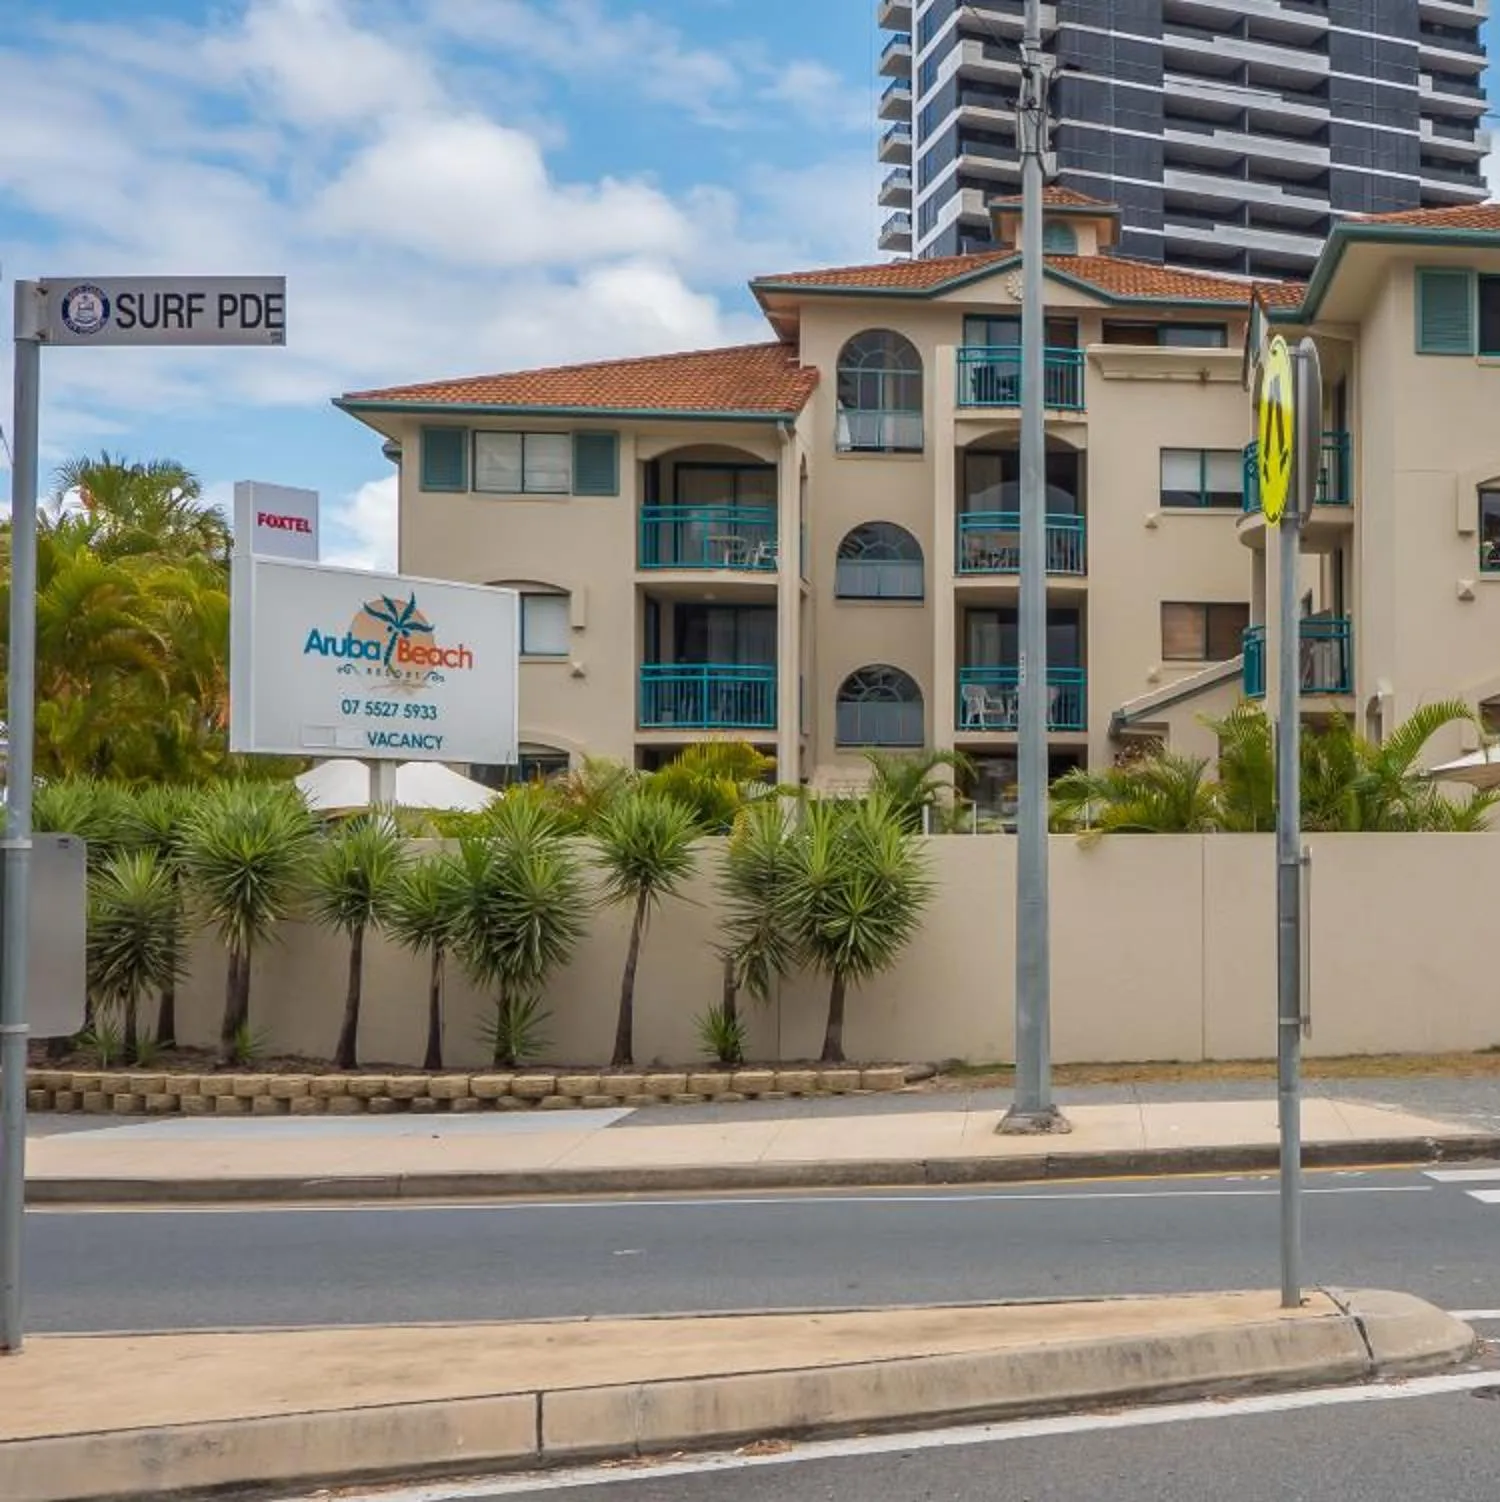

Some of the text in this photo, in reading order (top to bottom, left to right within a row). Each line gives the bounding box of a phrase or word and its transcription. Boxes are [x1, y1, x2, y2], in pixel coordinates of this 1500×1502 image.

[116, 293, 206, 329] SURF
[218, 293, 284, 329] PDE
[257, 511, 313, 533] FOXTEL
[303, 628, 473, 669] Aruba Beach
[341, 699, 438, 720] 07 5527 5933
[367, 731, 444, 751] VACANCY
